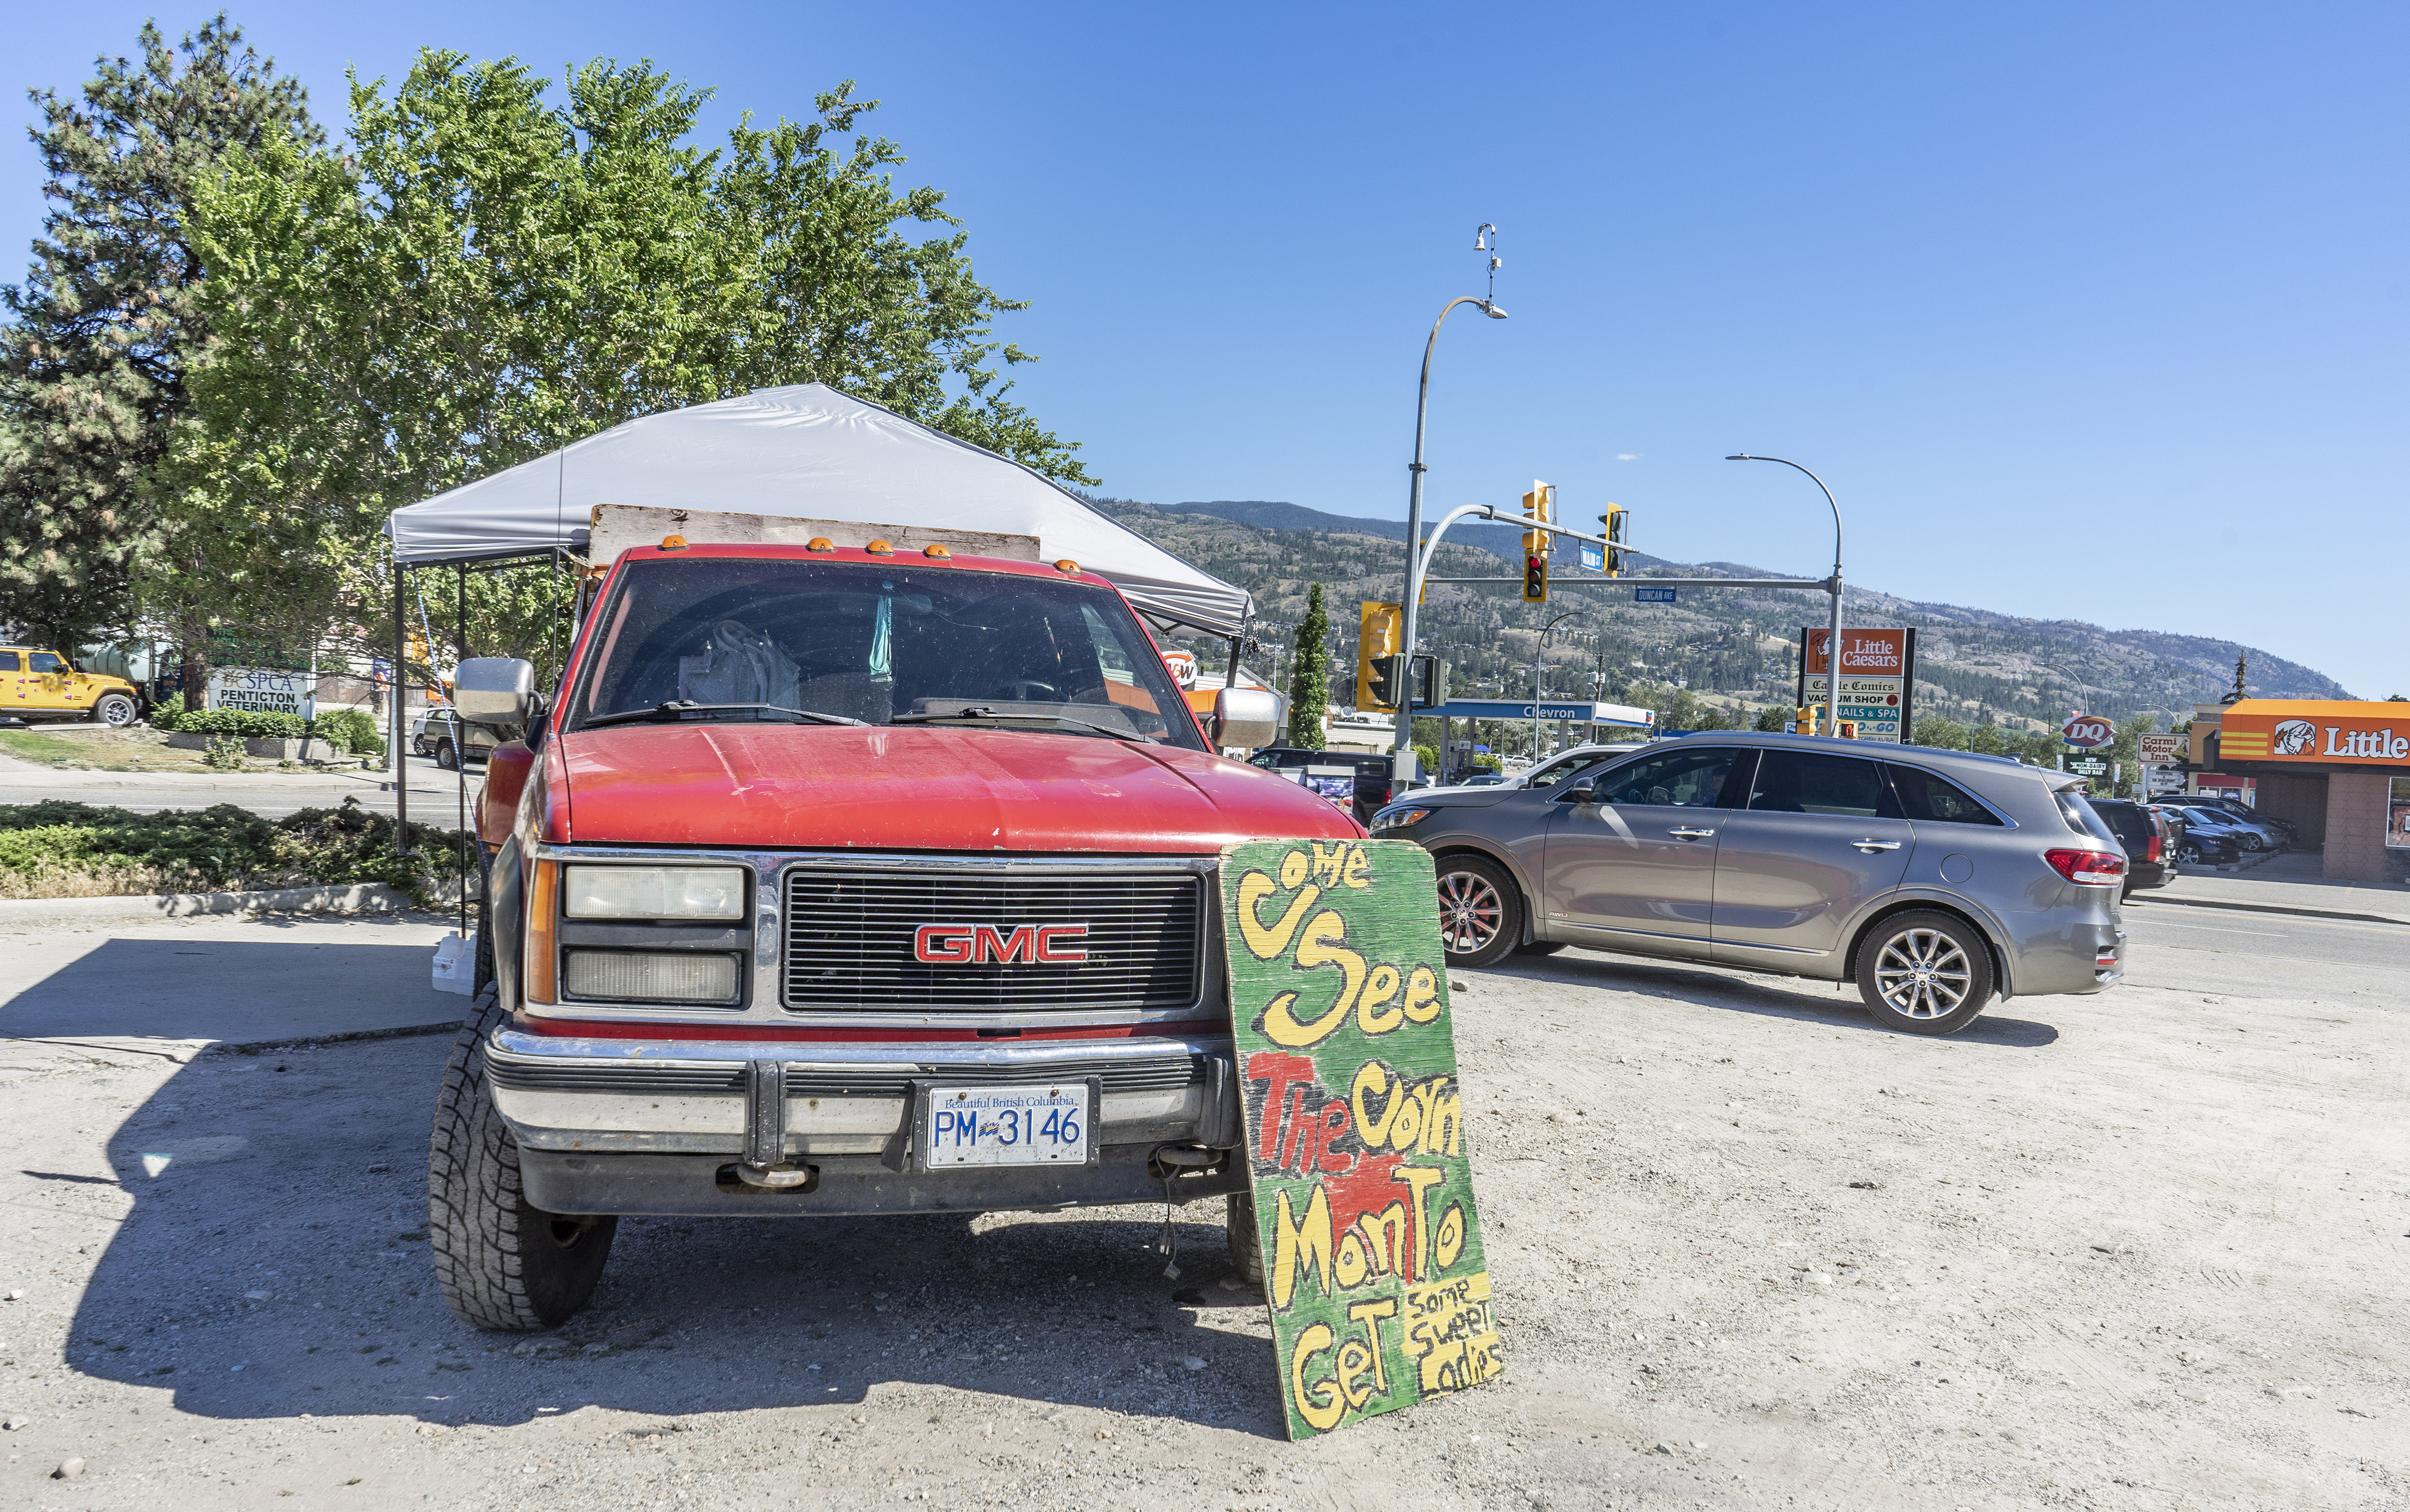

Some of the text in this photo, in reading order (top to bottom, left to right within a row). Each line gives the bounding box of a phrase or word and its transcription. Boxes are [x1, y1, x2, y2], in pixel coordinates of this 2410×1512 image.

[1582, 550, 1601, 567] MAIN ST
[1638, 590, 1673, 601] DUNCAN AVE
[1855, 639, 1893, 654] Little
[1843, 651, 1898, 667] Caesars
[1813, 681, 1894, 691] Cale Comics
[221, 690, 295, 703] PENTICTON
[1807, 695, 1851, 703] VACUM
[217, 699, 300, 714] VETERINARY
[1837, 709, 1864, 717] NAILS
[1877, 709, 1898, 718] SPA
[1876, 722, 1895, 733] GO
[2069, 724, 2105, 741] DQ
[2143, 737, 2177, 745] Carmi
[2323, 727, 2409, 759] Little
[2141, 745, 2172, 753] Motor
[2150, 752, 2169, 761] Inn
[914, 923, 1089, 964] GMC
[1251, 907, 1443, 1051] See
[945, 1096, 1074, 1108] Beautiful British Columbia
[1244, 1050, 1358, 1175] The
[935, 1107, 1080, 1146] PM 3146
